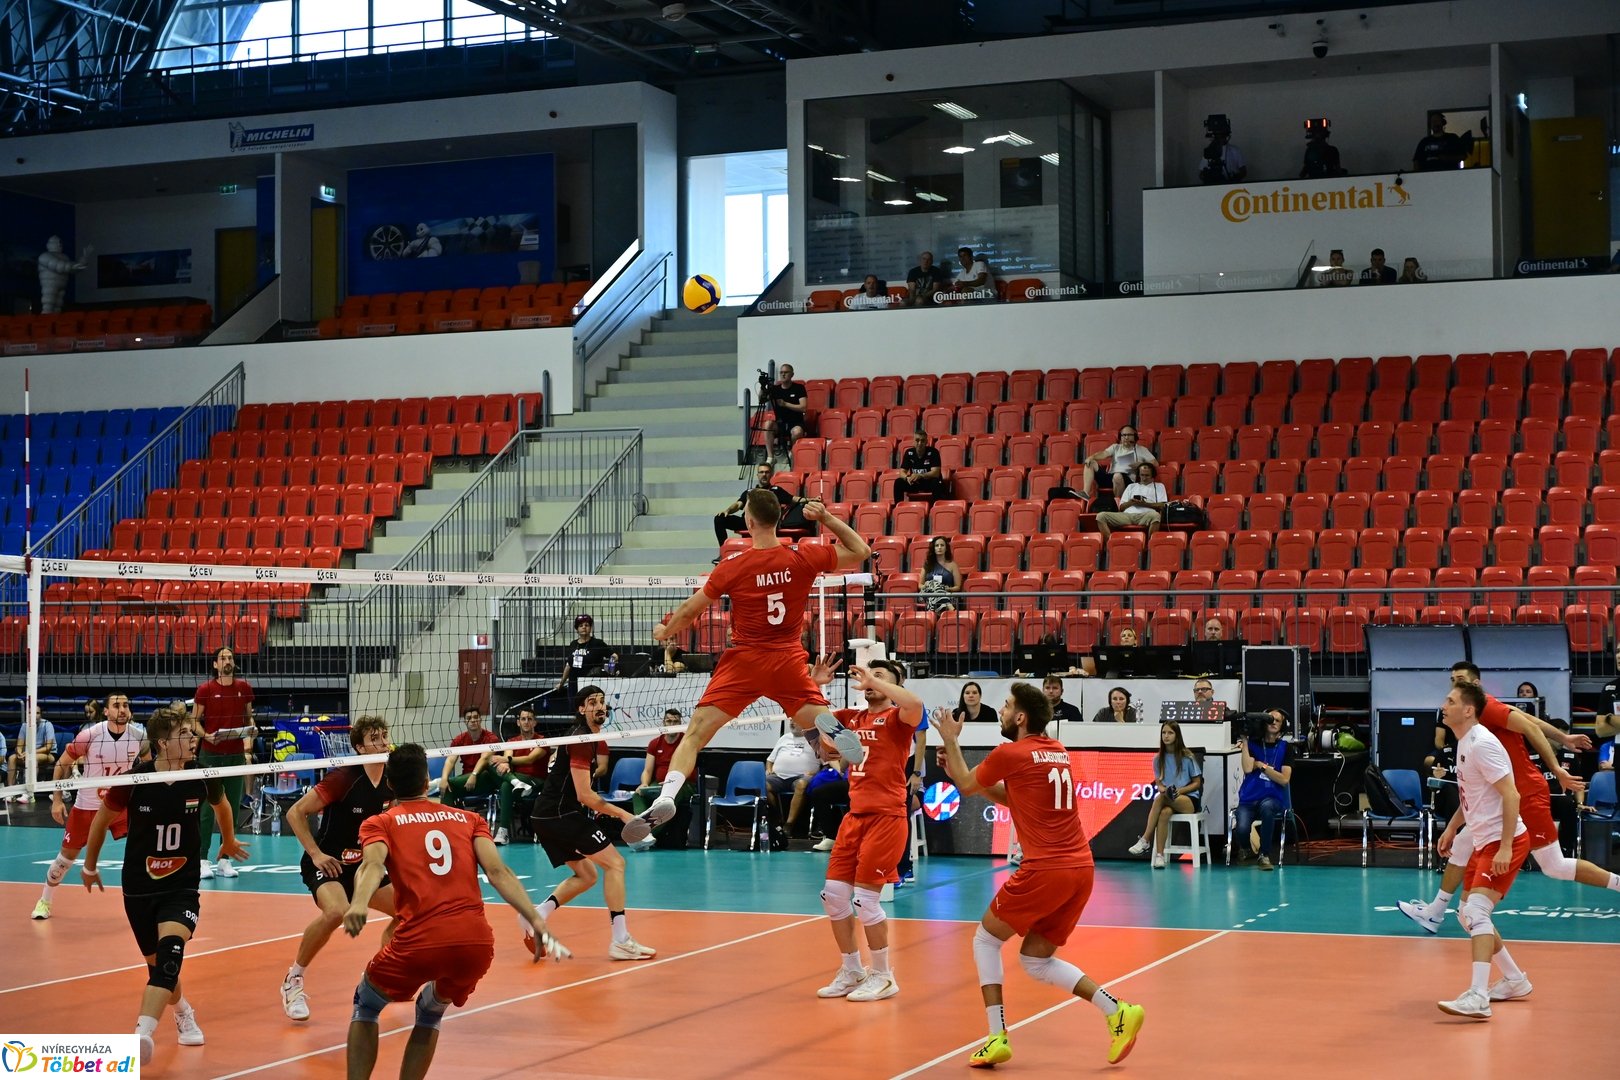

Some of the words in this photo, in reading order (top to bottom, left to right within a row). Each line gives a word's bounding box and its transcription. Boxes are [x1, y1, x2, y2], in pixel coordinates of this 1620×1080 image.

[246, 127, 312, 142] MICHELIN
[1221, 182, 1384, 223] Continental
[1518, 258, 1578, 274] Continental
[1024, 284, 1079, 299] Continental
[1118, 279, 1175, 295] Continental
[843, 293, 895, 309] Continental
[933, 289, 985, 304] Continental
[757, 298, 807, 313] Continental
[52, 562, 69, 571] CEV
[128, 565, 144, 574] CEV
[199, 567, 213, 576] CEV
[264, 569, 278, 578] CEV
[325, 571, 338, 580] CEV
[382, 572, 394, 581] CEV
[434, 574, 446, 582] CEV
[484, 575, 495, 583] CEV
[530, 576, 541, 584] CEV
[756, 567, 792, 587] MATIĆ
[767, 592, 786, 625] 5
[1047, 767, 1073, 810] 11
[394, 811, 468, 826] MANDIRACI
[156, 823, 181, 852] 10
[591, 830, 607, 844] 12
[424, 829, 452, 876] 9
[316, 870, 324, 880] 5
